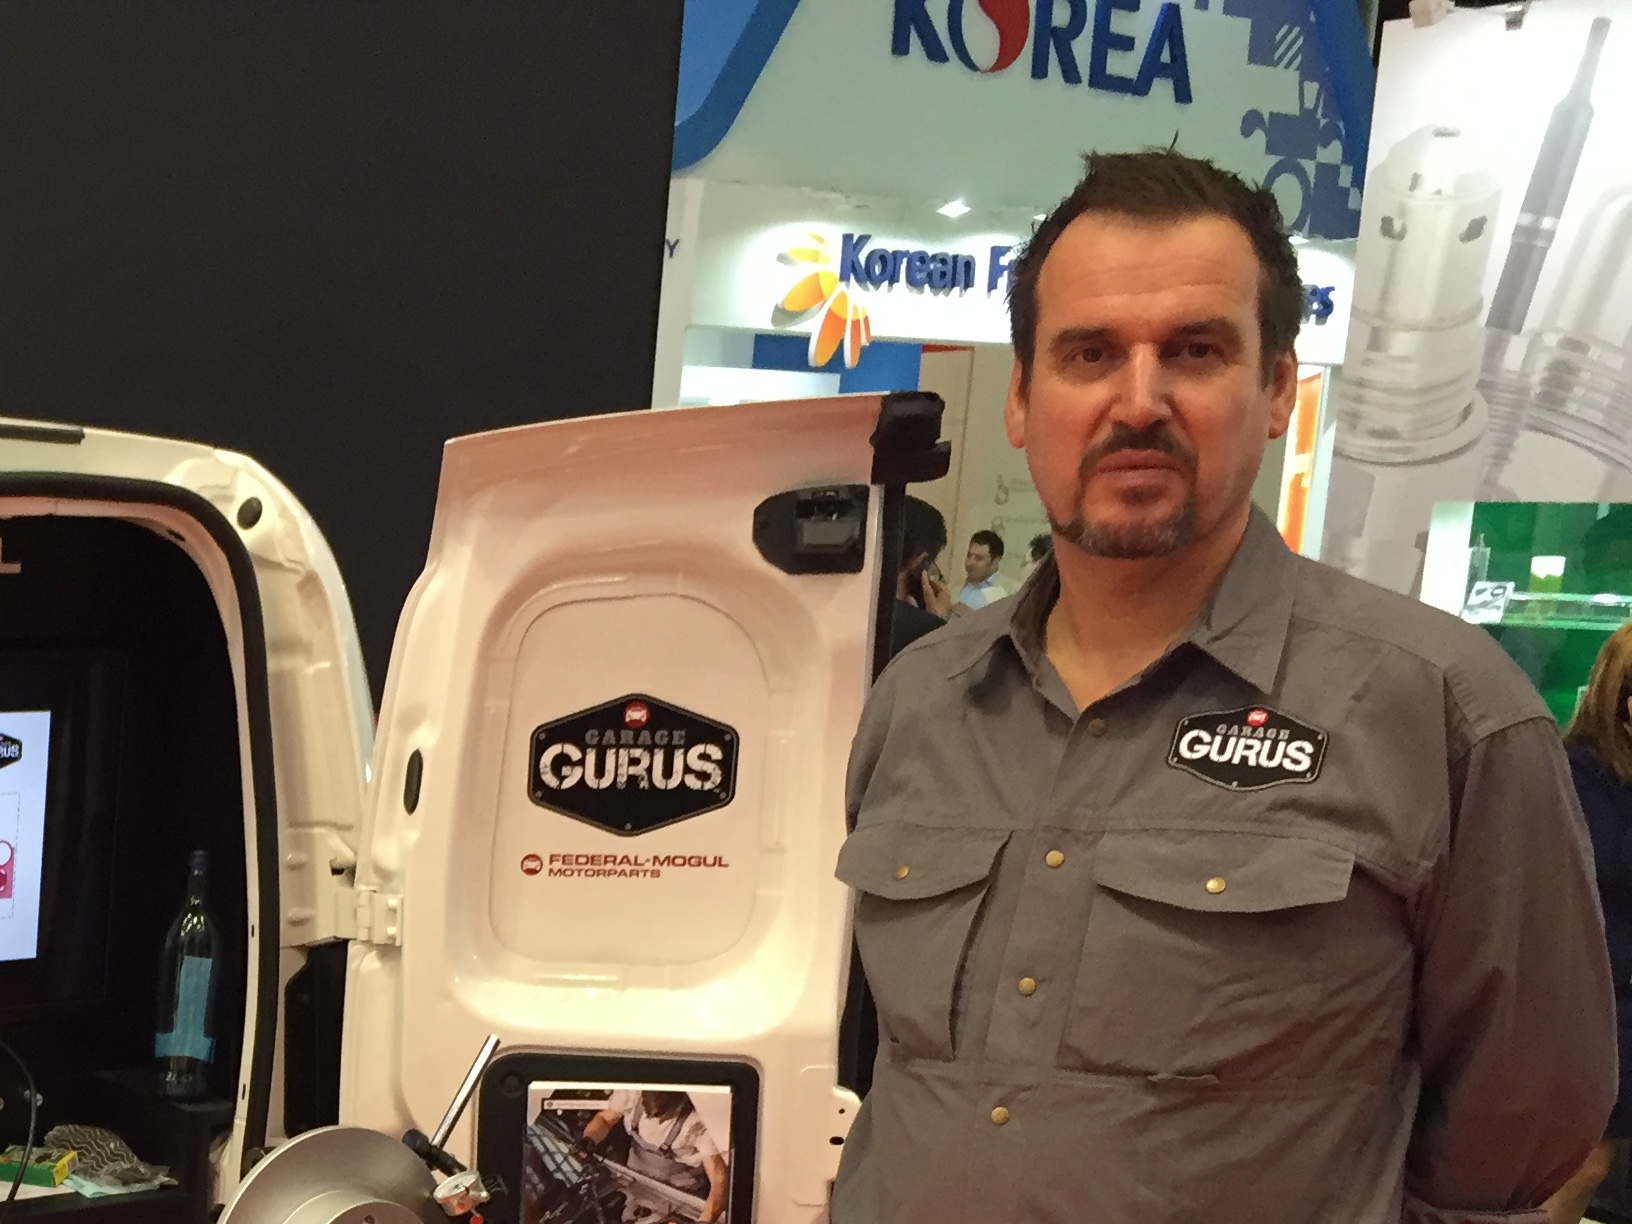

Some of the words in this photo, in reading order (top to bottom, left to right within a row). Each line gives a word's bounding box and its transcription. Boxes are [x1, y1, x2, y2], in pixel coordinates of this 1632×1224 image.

[891, 0, 1193, 104] KOREA
[839, 232, 976, 290] Korean
[585, 729, 687, 746] GARAGE
[1216, 723, 1290, 740] GARAGE
[1179, 729, 1314, 772] GURUS
[539, 743, 723, 790] GURUS
[548, 853, 730, 868] FEDERAL-MOGUL
[548, 868, 661, 879] MOTORPARTS
